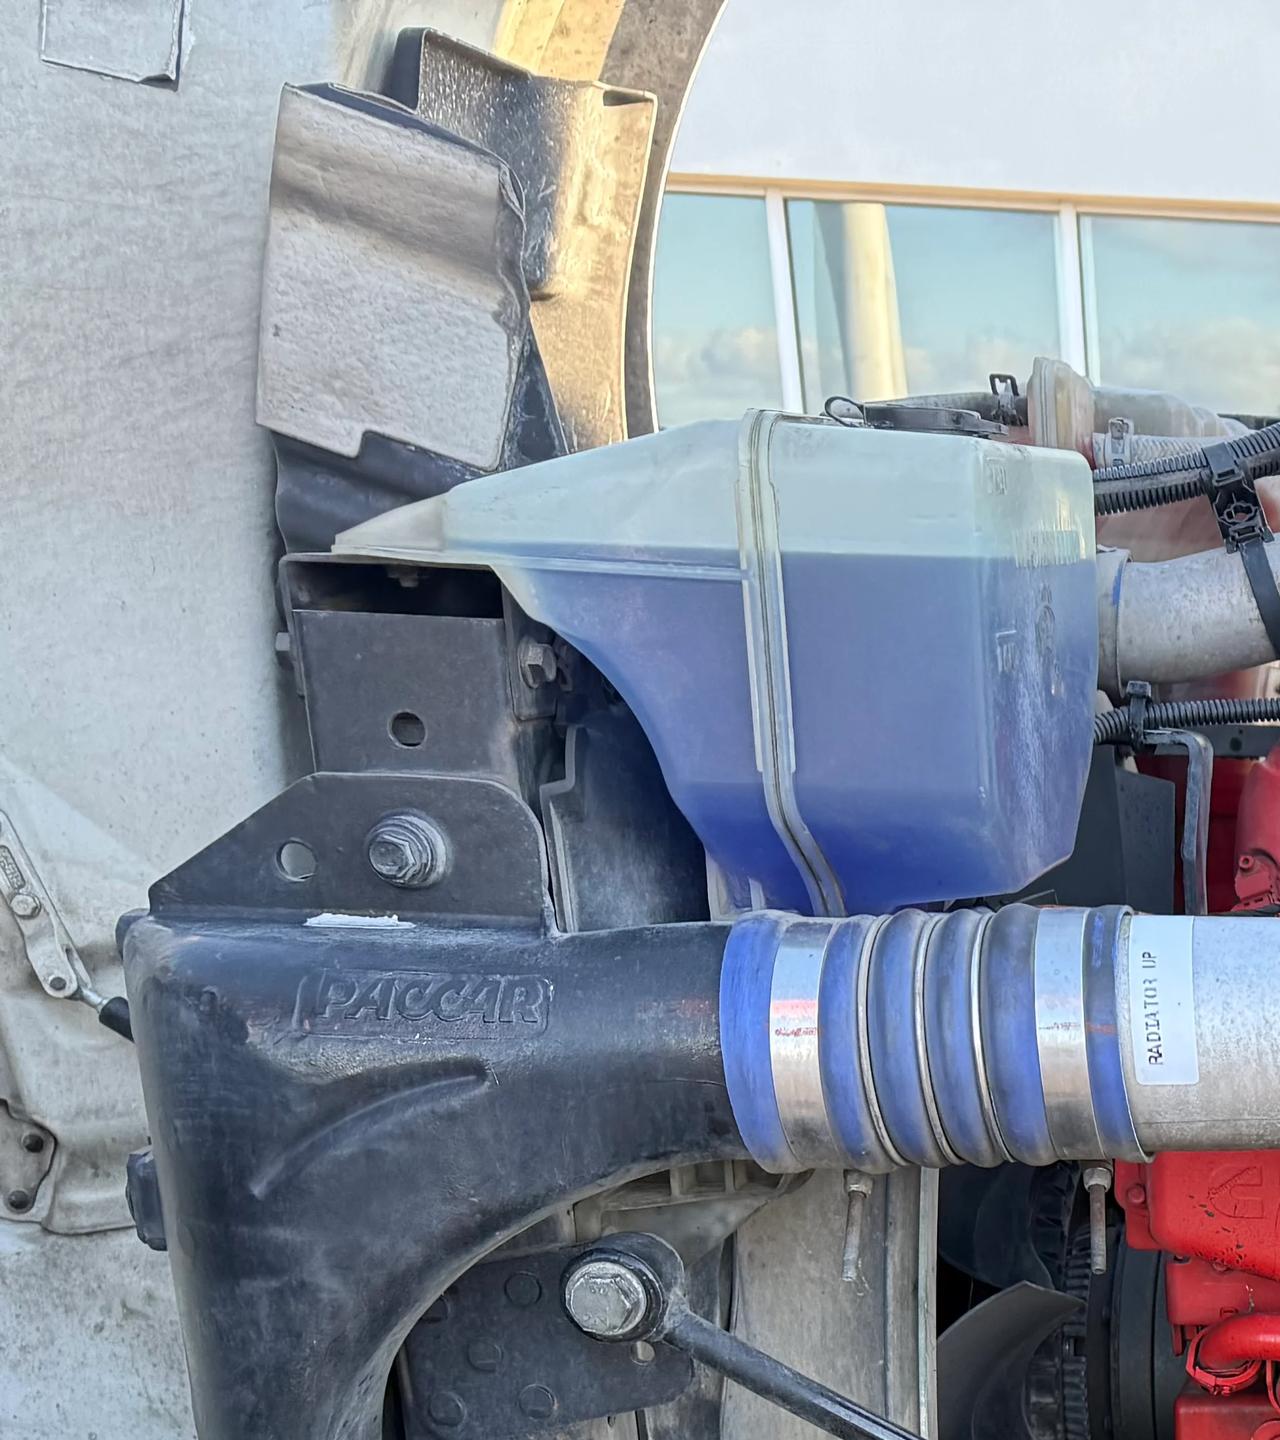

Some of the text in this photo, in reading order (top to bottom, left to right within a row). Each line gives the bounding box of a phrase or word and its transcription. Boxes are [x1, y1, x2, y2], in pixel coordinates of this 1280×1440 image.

[316, 974, 545, 1023] PACCAR
[1142, 951, 1164, 1066] RADIATOR UP
